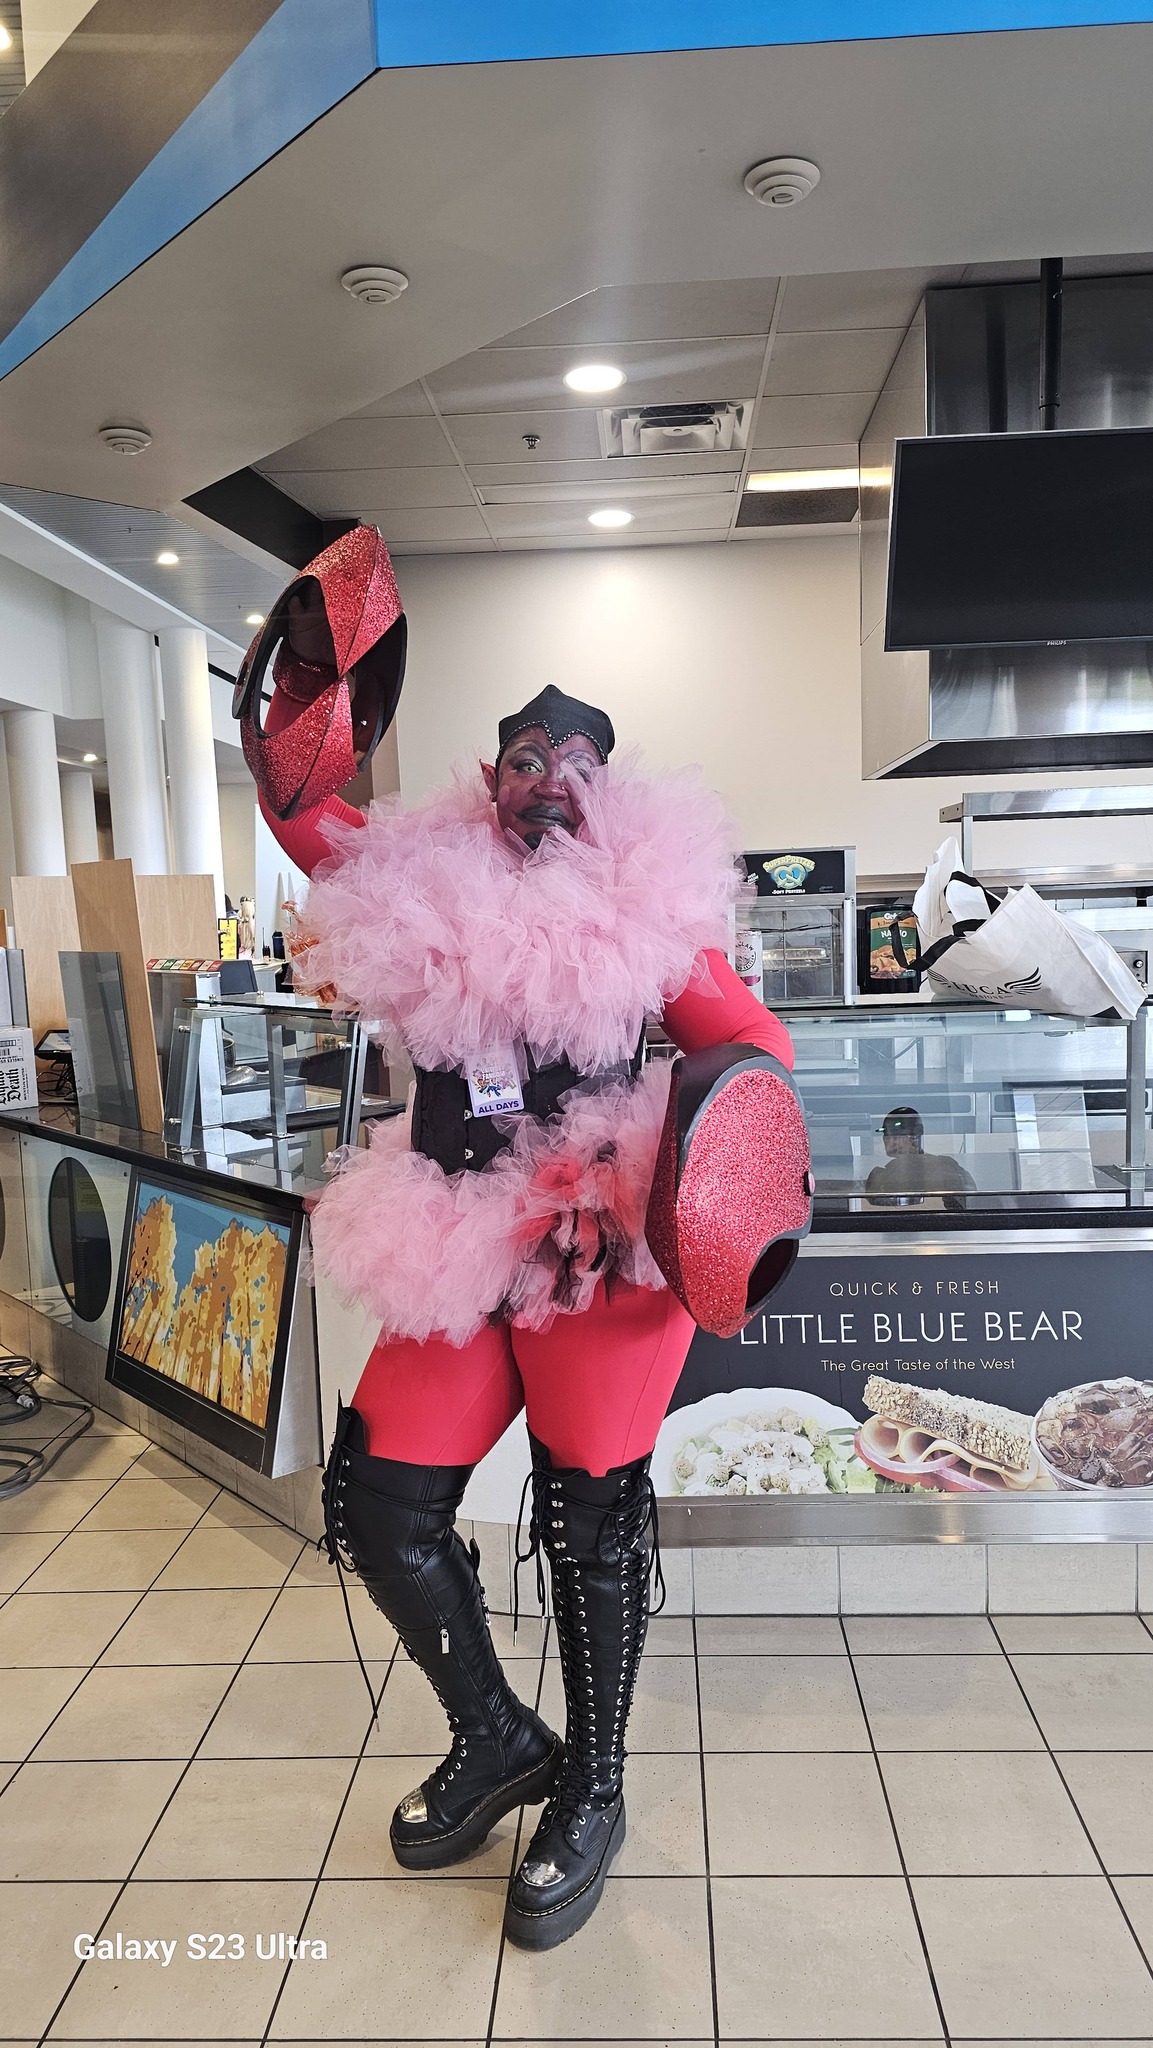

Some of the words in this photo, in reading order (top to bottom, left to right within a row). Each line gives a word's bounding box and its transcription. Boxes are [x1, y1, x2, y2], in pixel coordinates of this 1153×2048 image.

[881, 929, 908, 939] NAO
[950, 980, 1012, 995] LUCA
[5, 1068, 21, 1102] Death
[478, 1105, 495, 1114] ALL
[495, 1101, 520, 1111] DAYS
[829, 1282, 899, 1297] QUICK
[911, 1281, 923, 1295] &
[936, 1280, 1000, 1295] FRESH
[740, 1313, 858, 1345] LITTLE
[873, 1312, 968, 1344] BLUE
[984, 1310, 1083, 1342] BEAR
[820, 1359, 846, 1372] The
[850, 1359, 889, 1372] Great
[894, 1358, 931, 1371] Taste
[935, 1358, 949, 1371] of
[952, 1358, 976, 1370] the
[979, 1357, 1016, 1370] West
